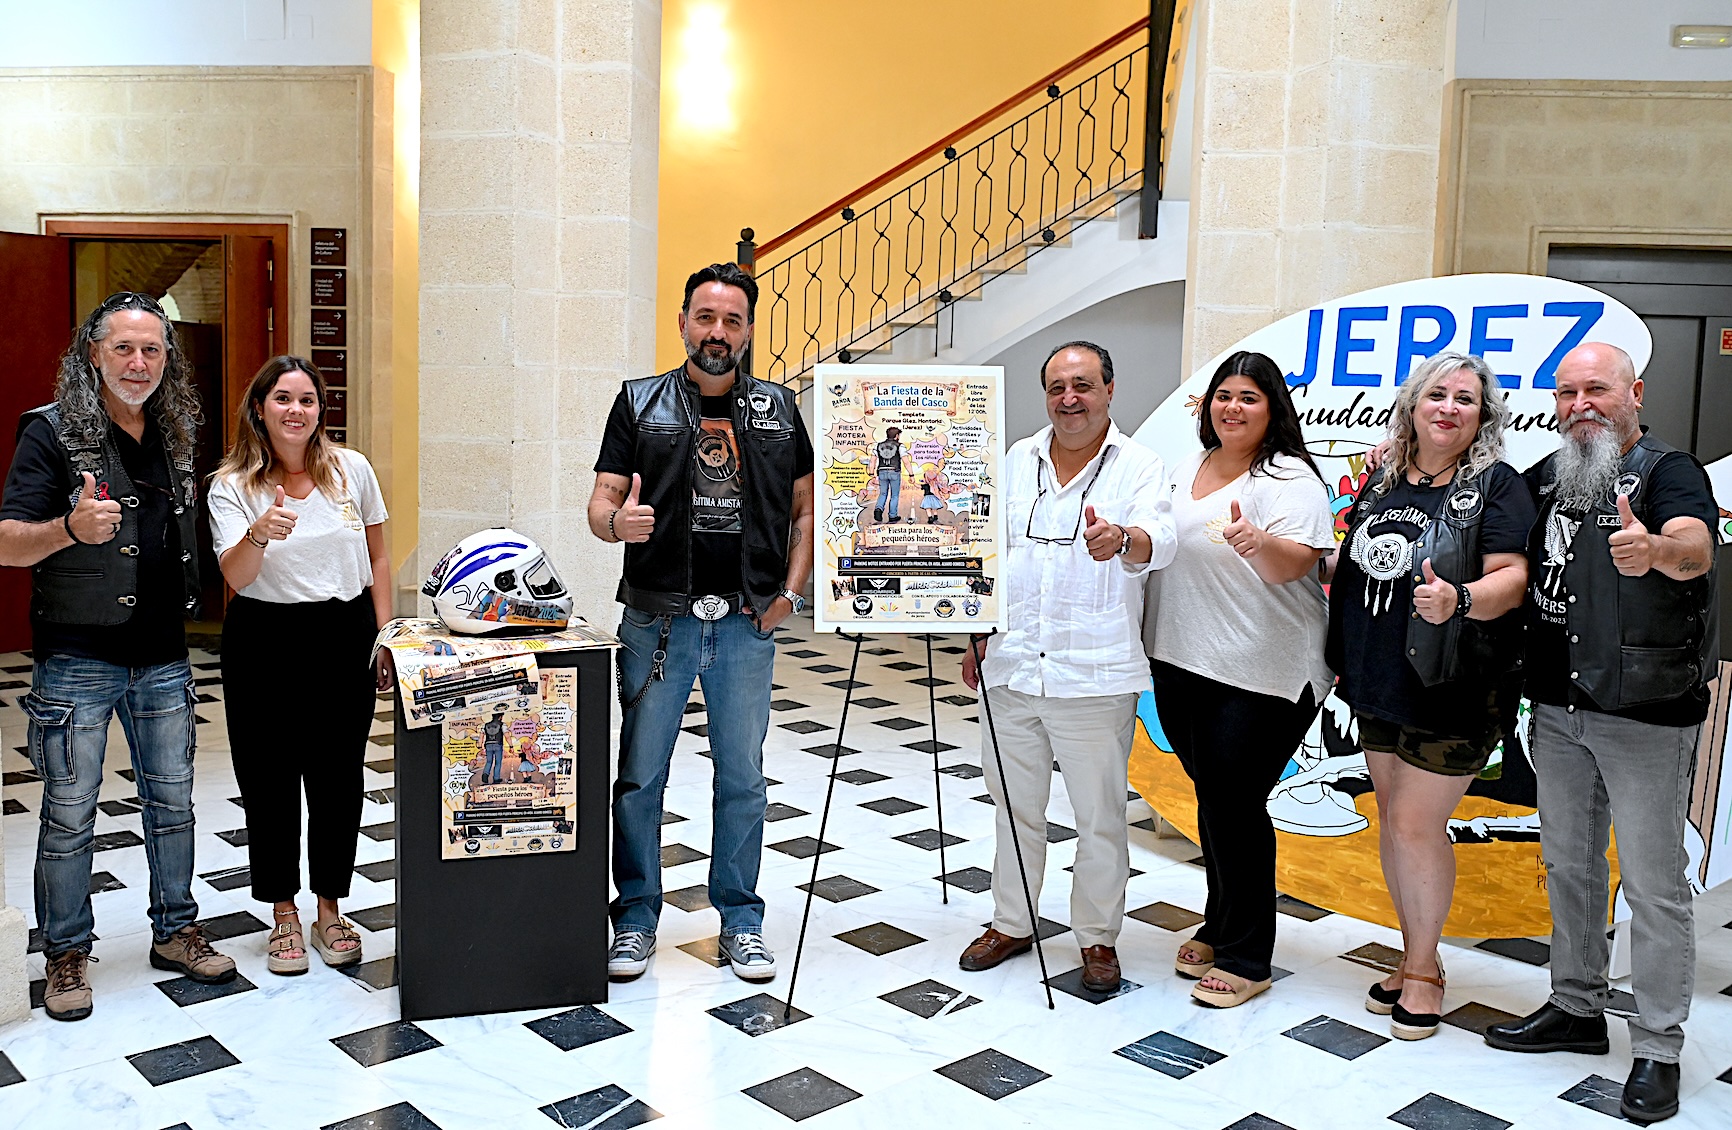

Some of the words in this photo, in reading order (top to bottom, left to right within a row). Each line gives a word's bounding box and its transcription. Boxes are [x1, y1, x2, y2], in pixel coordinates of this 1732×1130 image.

[1284, 302, 1604, 389] JEREZ
[877, 386, 889, 396] La
[891, 385, 919, 396] Fiesta
[921, 386, 933, 396] de
[936, 387, 944, 396] la
[874, 397, 903, 407] Banda
[905, 397, 919, 407] del
[921, 397, 948, 408] Casco
[716, 497, 743, 509] AMISTA
[881, 534, 915, 543] pequeños
[916, 534, 940, 543] héroes
